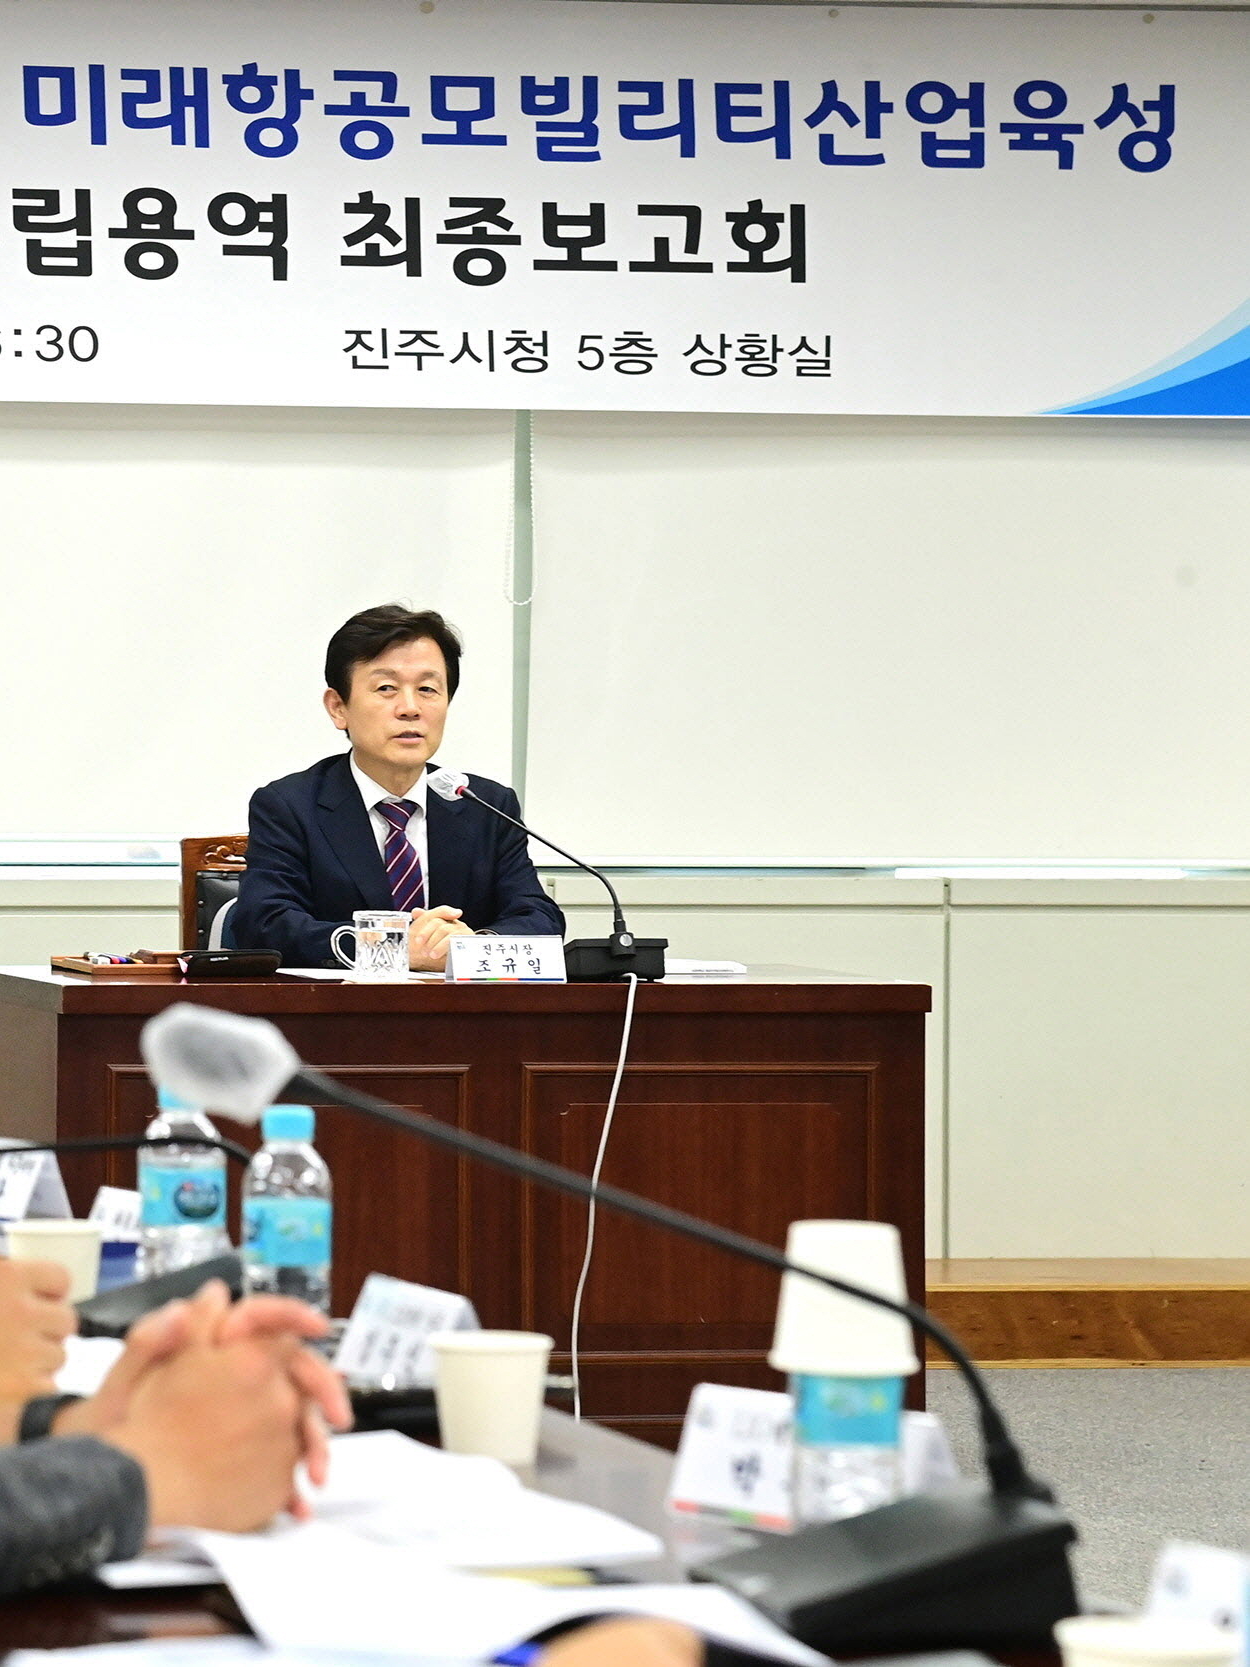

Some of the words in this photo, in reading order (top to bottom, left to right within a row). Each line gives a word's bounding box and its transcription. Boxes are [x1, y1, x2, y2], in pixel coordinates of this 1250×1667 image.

[23, 62, 1175, 172] 미래항공모빌리티산업육성
[341, 191, 805, 286] 최종보고회
[343, 328, 548, 373] 진주시청
[578, 332, 657, 374] 5층
[683, 334, 831, 377] 상황실
[476, 957, 541, 975] 조규일
[482, 943, 534, 956] 진주시장
